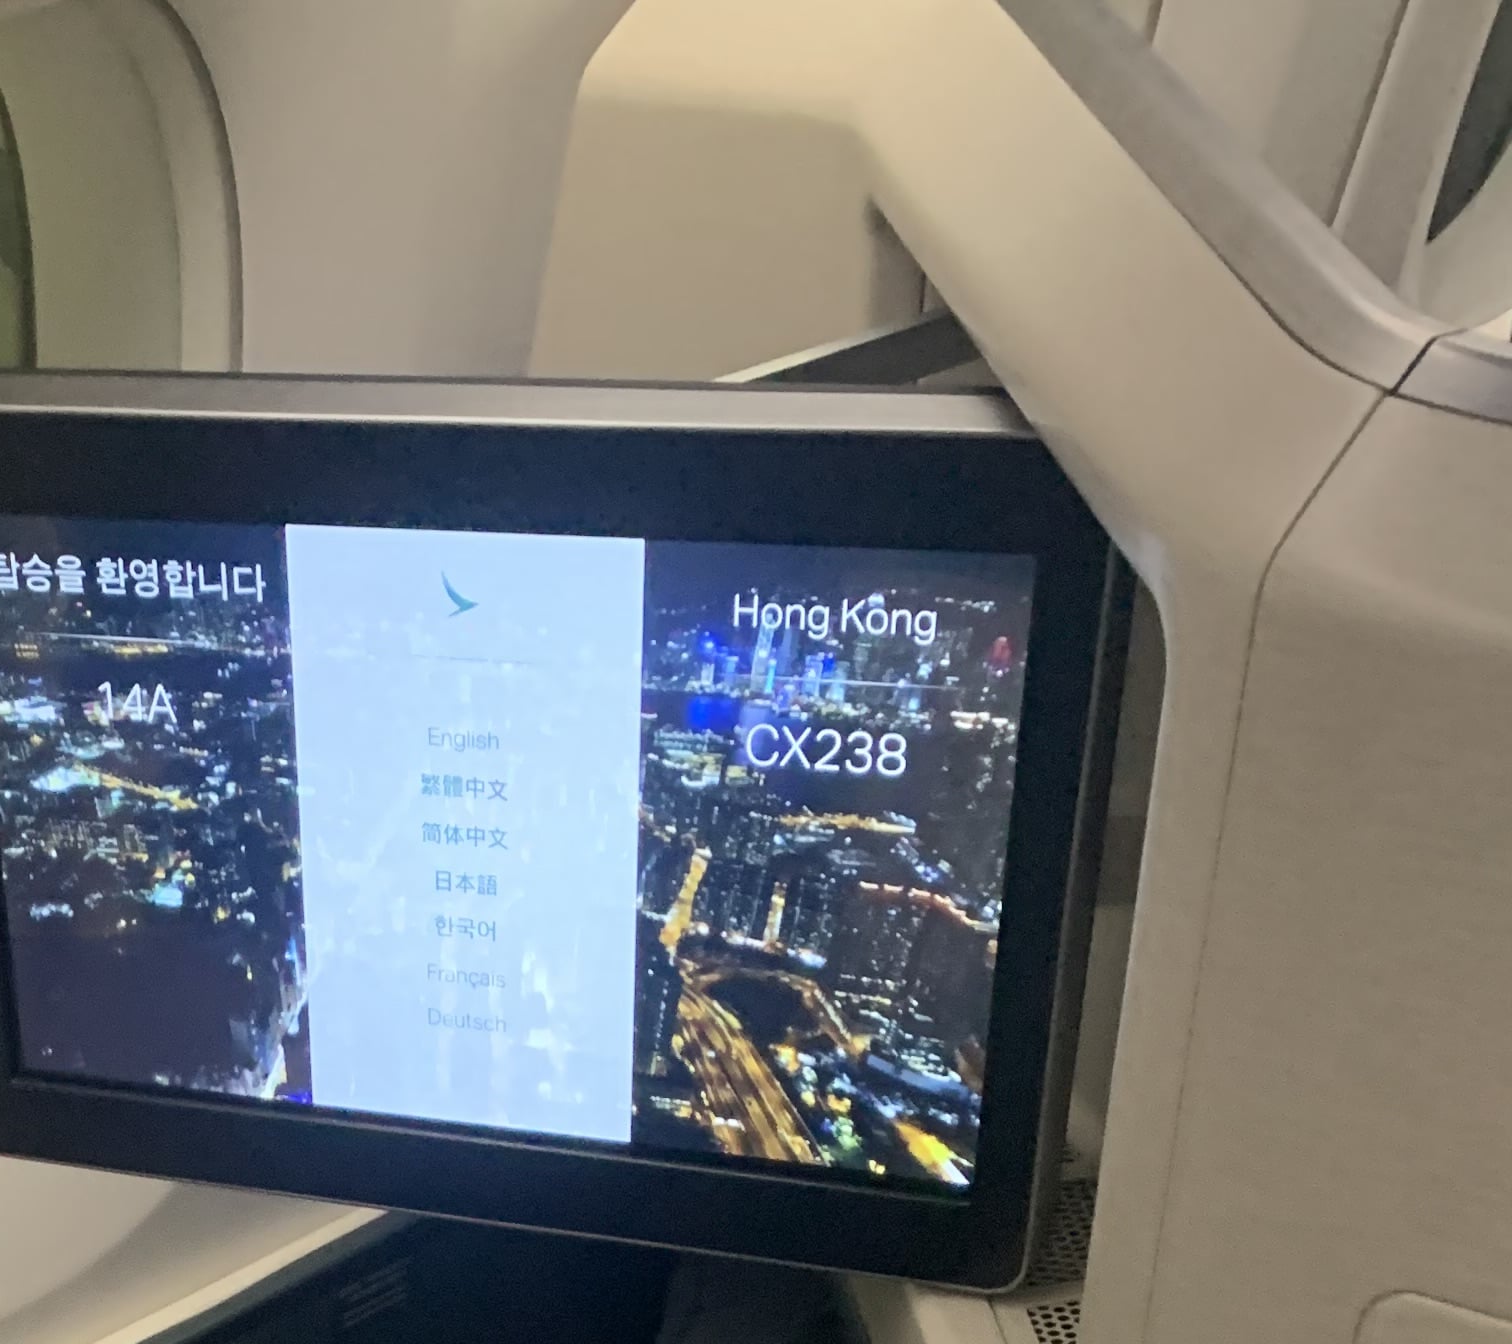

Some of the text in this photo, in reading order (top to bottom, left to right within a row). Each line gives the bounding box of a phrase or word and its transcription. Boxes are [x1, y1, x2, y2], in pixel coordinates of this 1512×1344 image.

[96, 556, 266, 602] 환영합니다
[732, 593, 938, 646] Hong Kong
[98, 681, 178, 725] 14A
[427, 726, 500, 752] English
[746, 723, 907, 777] CX238
[421, 773, 508, 802] 繁體中文
[422, 822, 508, 850] 简体中文
[435, 870, 497, 896] 日本語
[434, 915, 496, 942] 한국어
[427, 963, 506, 989] Français
[427, 1007, 507, 1032] Deutsch
